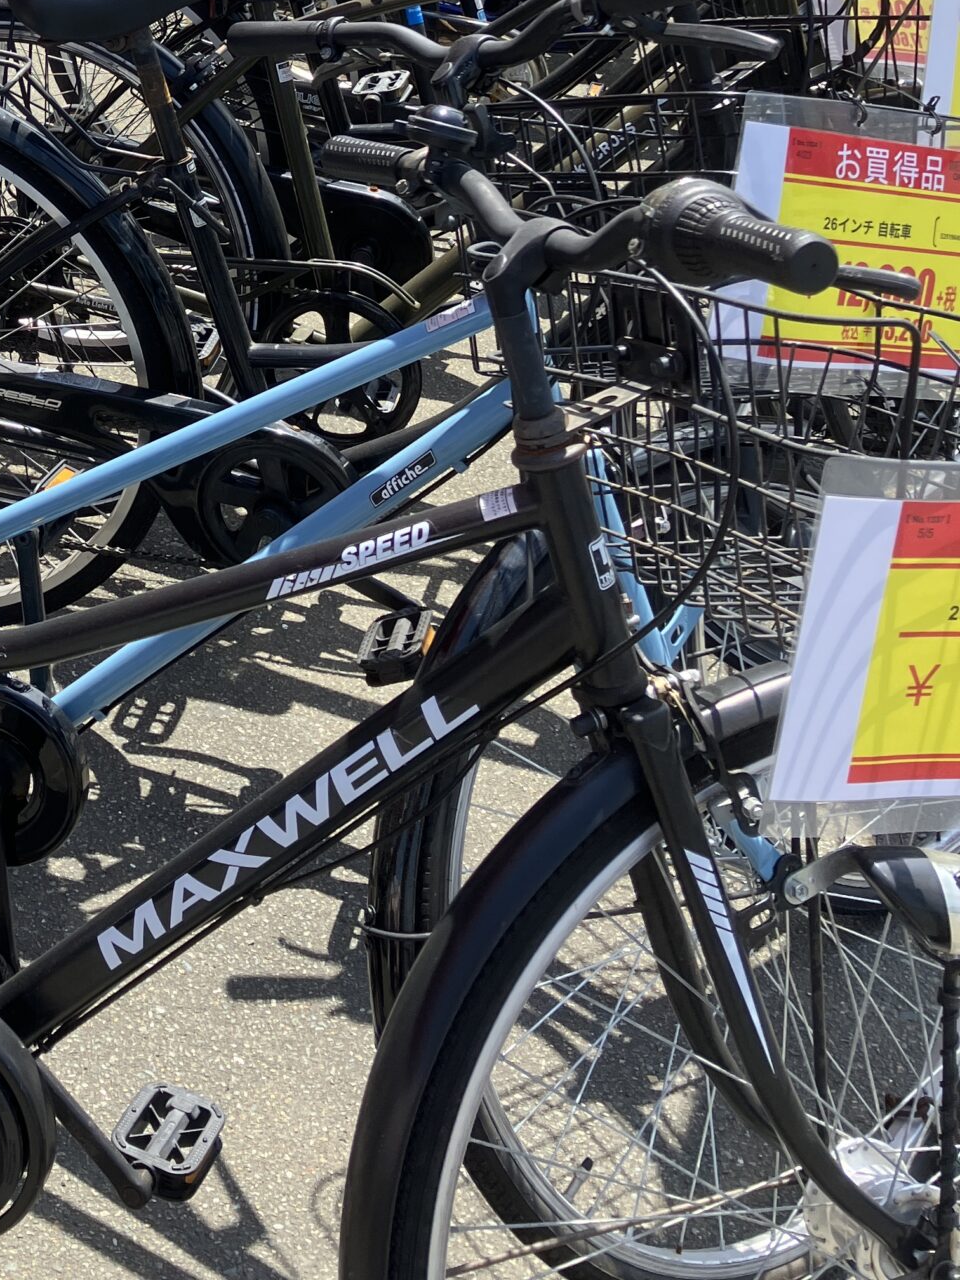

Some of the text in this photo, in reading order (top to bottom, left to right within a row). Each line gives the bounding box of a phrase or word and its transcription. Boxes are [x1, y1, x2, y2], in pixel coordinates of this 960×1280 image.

[835, 143, 945, 192] お買得品
[823, 217, 912, 240] 26インチ 自転車
[936, 286, 957, 312] +税
[381, 463, 429, 500] affiche
[341, 521, 430, 570] SPEED
[905, 664, 941, 707] ¥
[96, 695, 480, 971] MAXWELL
